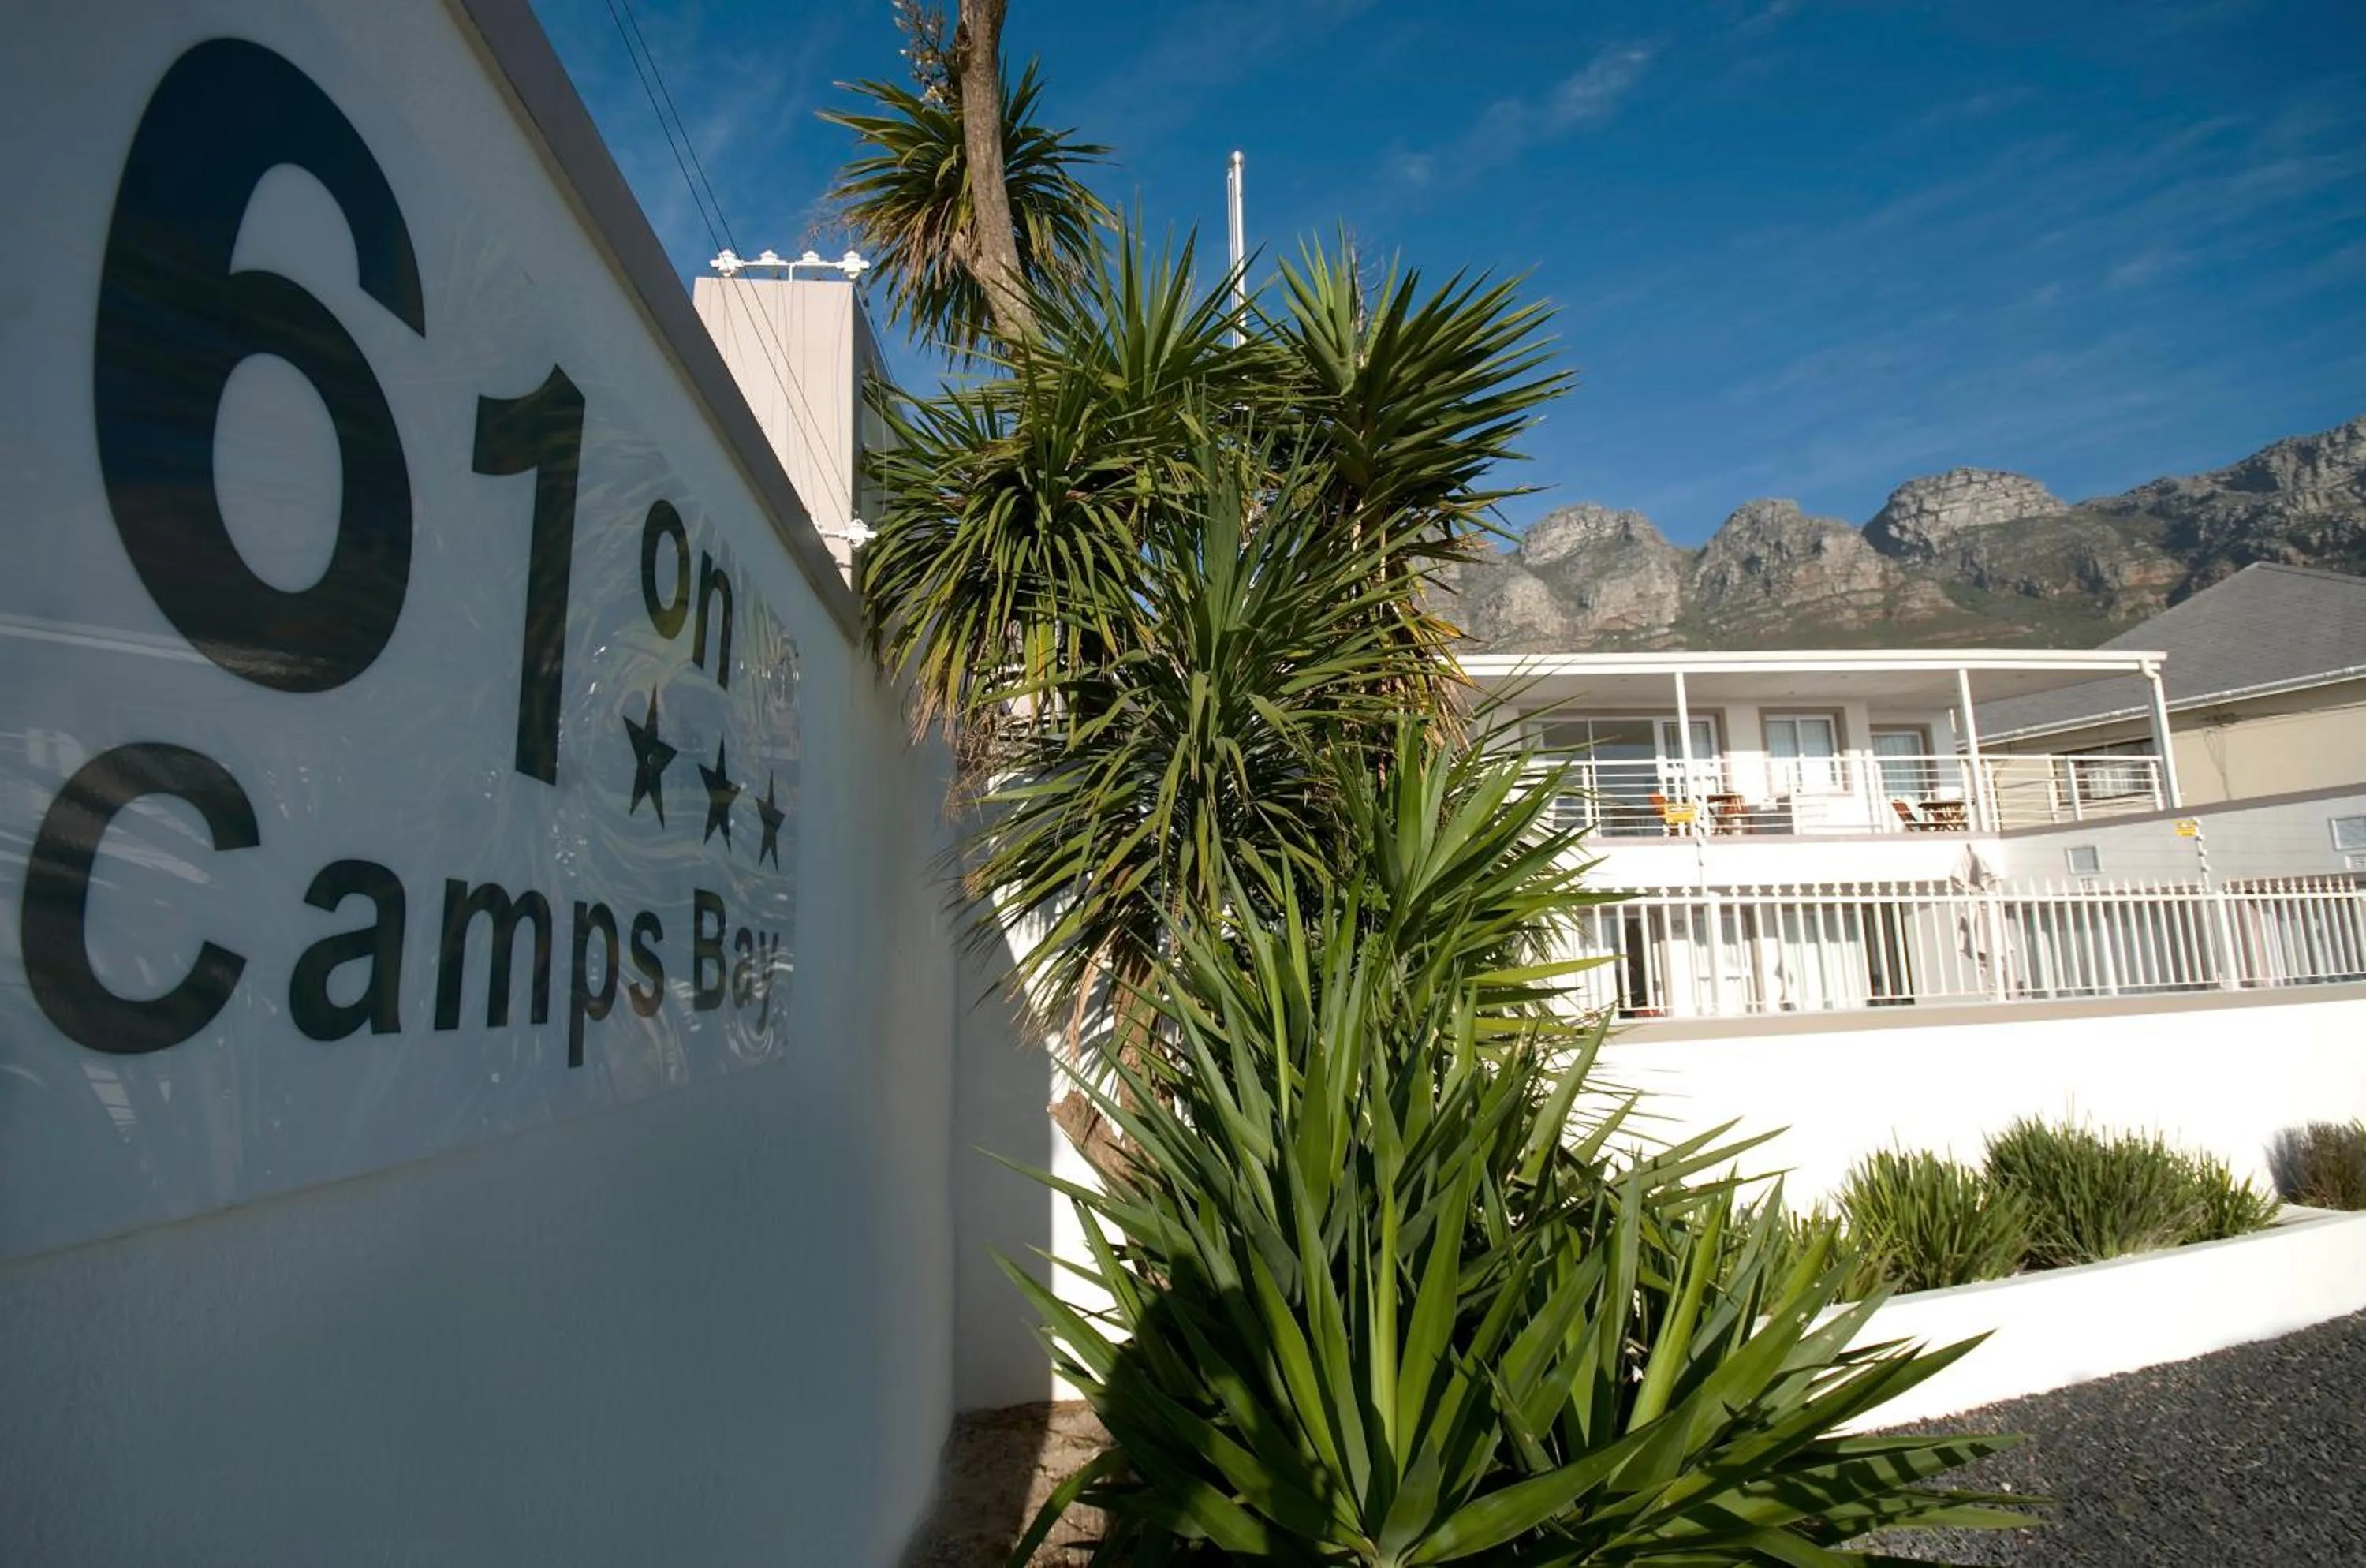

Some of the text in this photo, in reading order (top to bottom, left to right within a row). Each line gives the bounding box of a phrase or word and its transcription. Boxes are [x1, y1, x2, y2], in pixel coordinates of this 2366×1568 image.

[93, 37, 585, 786] 61
[21, 741, 779, 1068] Camps Bay
